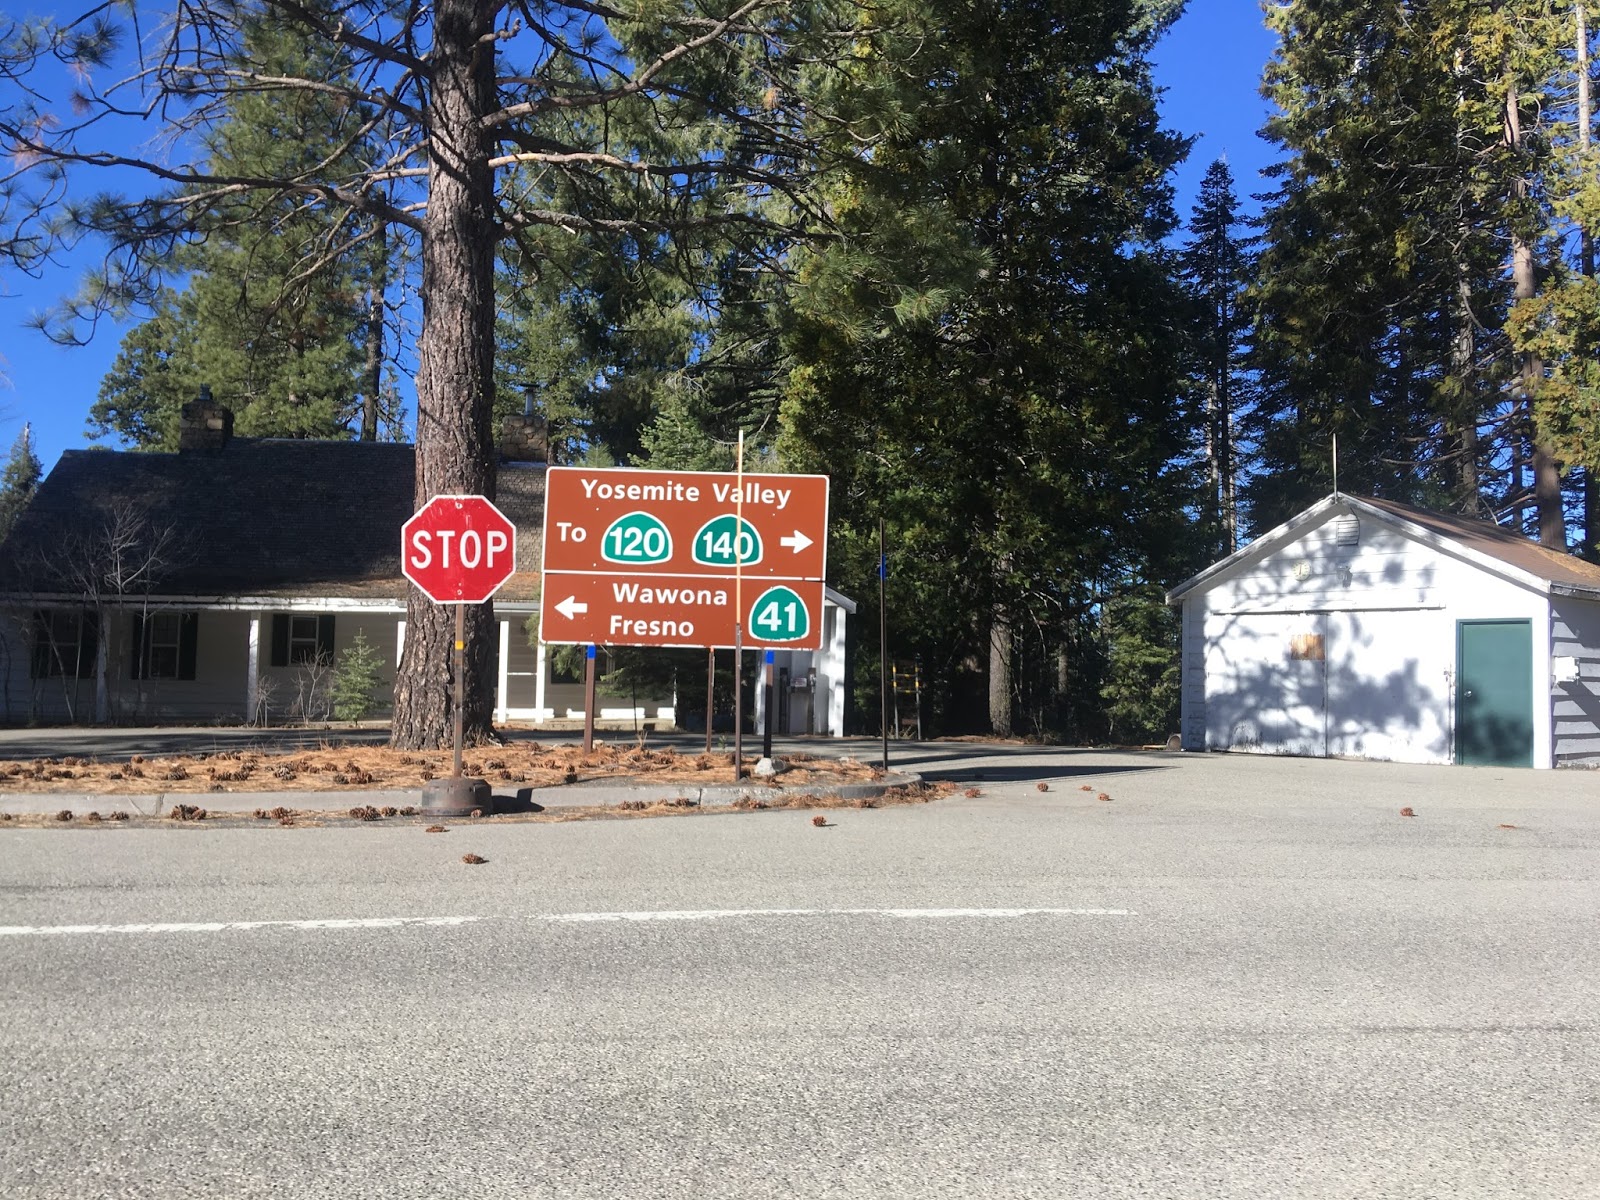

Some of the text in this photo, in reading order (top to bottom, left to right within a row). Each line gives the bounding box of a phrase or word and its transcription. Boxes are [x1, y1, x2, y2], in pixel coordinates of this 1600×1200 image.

[580, 478, 792, 510] Yosemite Valley
[409, 528, 509, 569] STOP
[556, 522, 754, 560] To 120 140
[612, 582, 728, 606] Wawona
[609, 614, 694, 637] Fresno
[757, 601, 797, 632] 41
